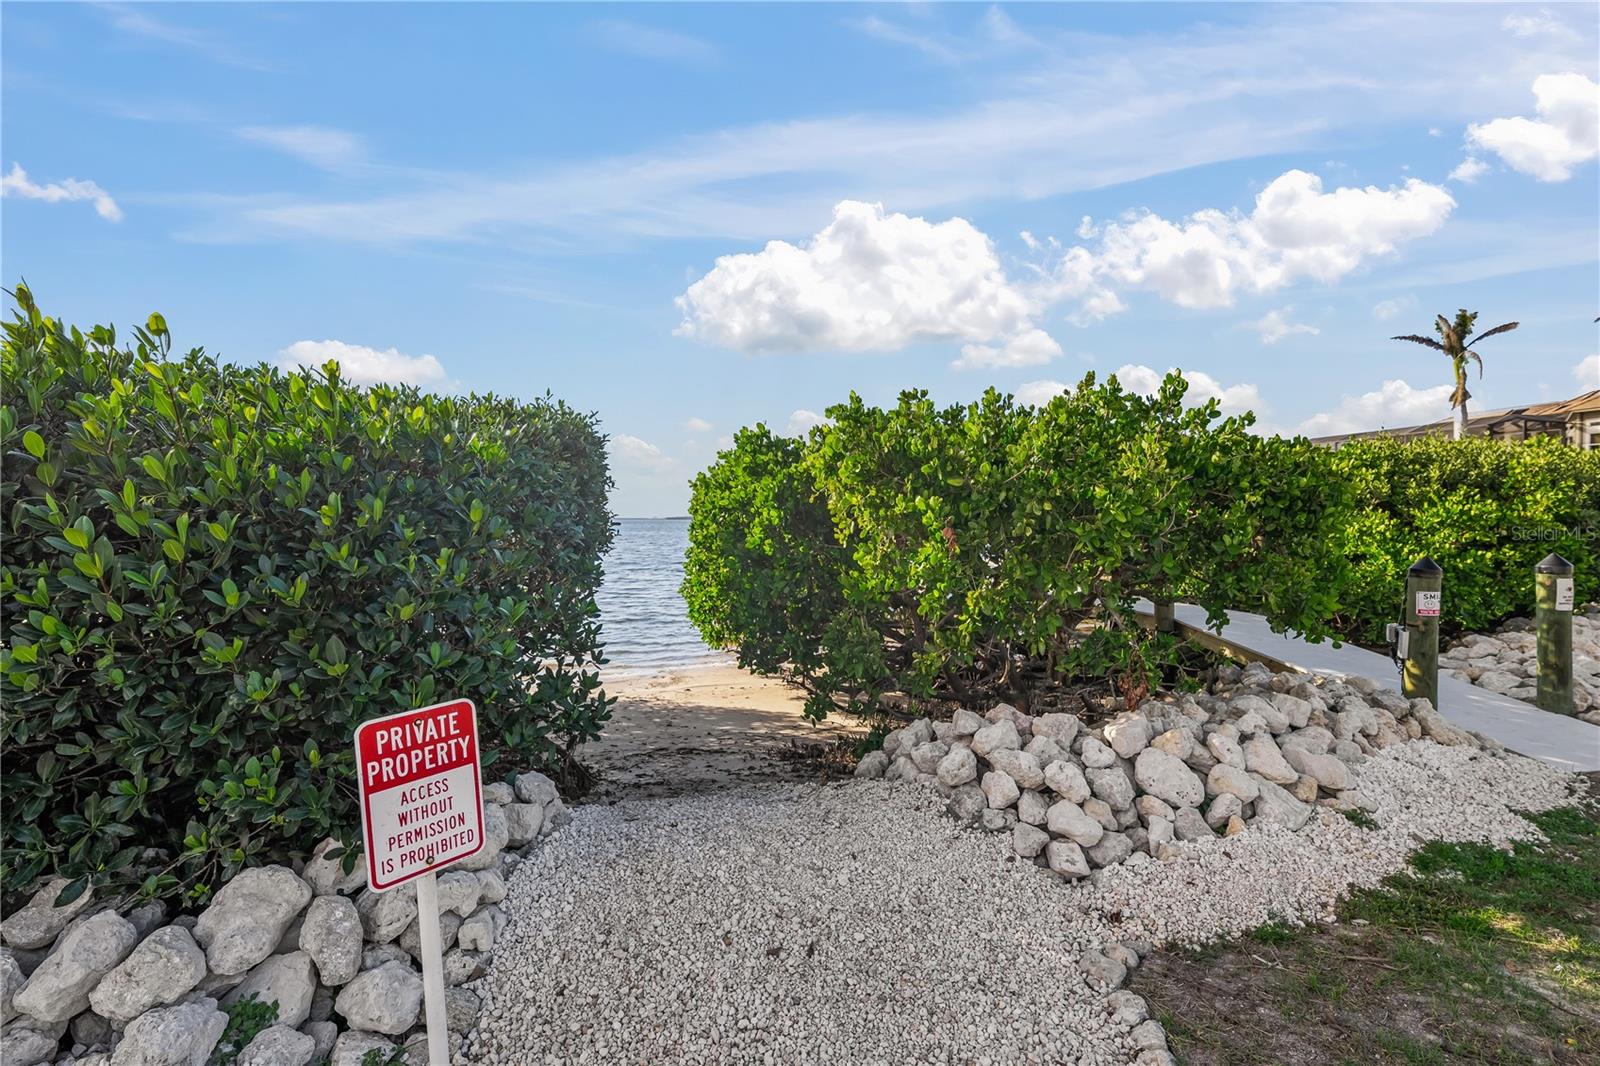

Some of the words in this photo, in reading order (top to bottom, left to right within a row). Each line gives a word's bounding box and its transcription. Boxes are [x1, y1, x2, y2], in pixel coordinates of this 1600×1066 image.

[375, 711, 460, 755] PRIVATE
[366, 735, 471, 787] PROPERTY
[397, 796, 454, 827] WITHOUT
[400, 778, 449, 806] ACCESS
[381, 859, 394, 875] IS
[400, 828, 475, 869] PROHIBITED
[388, 812, 466, 852] PERMISSION
